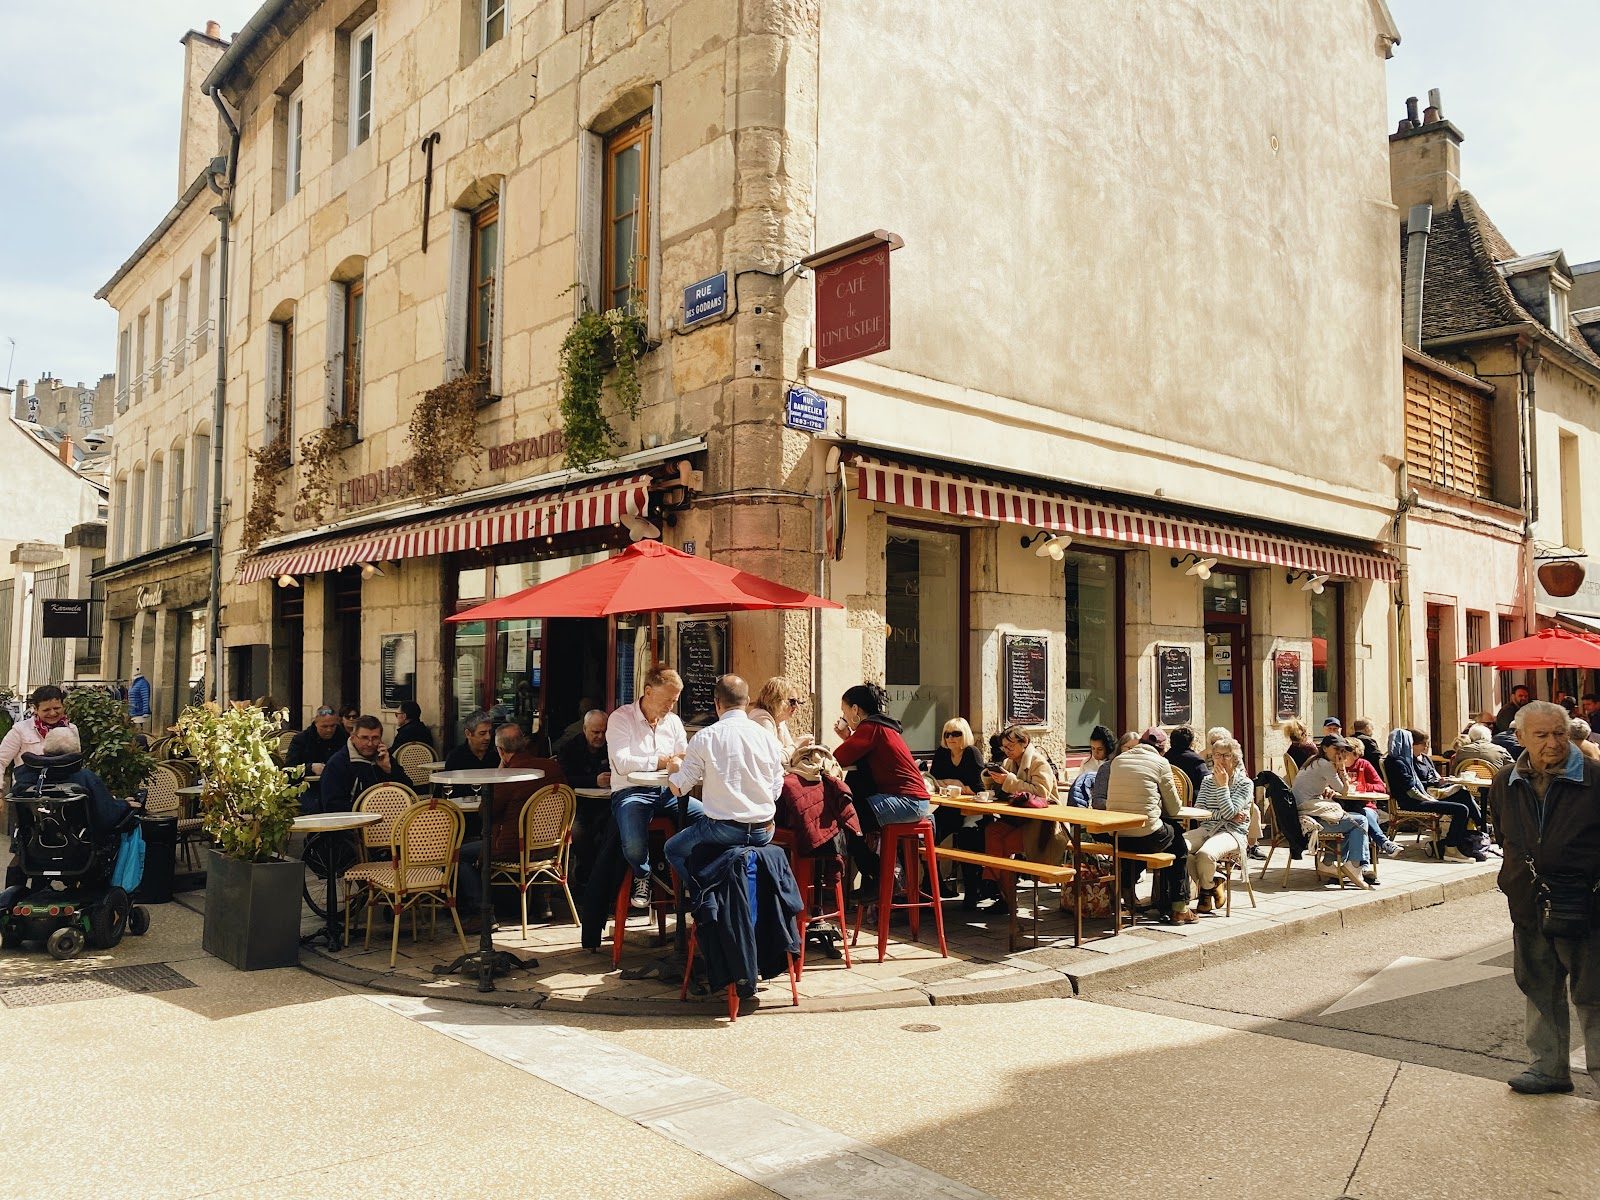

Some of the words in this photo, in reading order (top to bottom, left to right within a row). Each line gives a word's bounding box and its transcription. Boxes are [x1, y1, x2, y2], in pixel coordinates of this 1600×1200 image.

[695, 284, 712, 300] RUE
[836, 272, 866, 299] CAFÉ
[686, 308, 695, 319] DES
[695, 296, 722, 315] GODRANS
[822, 315, 881, 348] L'INDUSTRIE
[793, 402, 823, 416] BANNELIER
[802, 396, 814, 406] RUE
